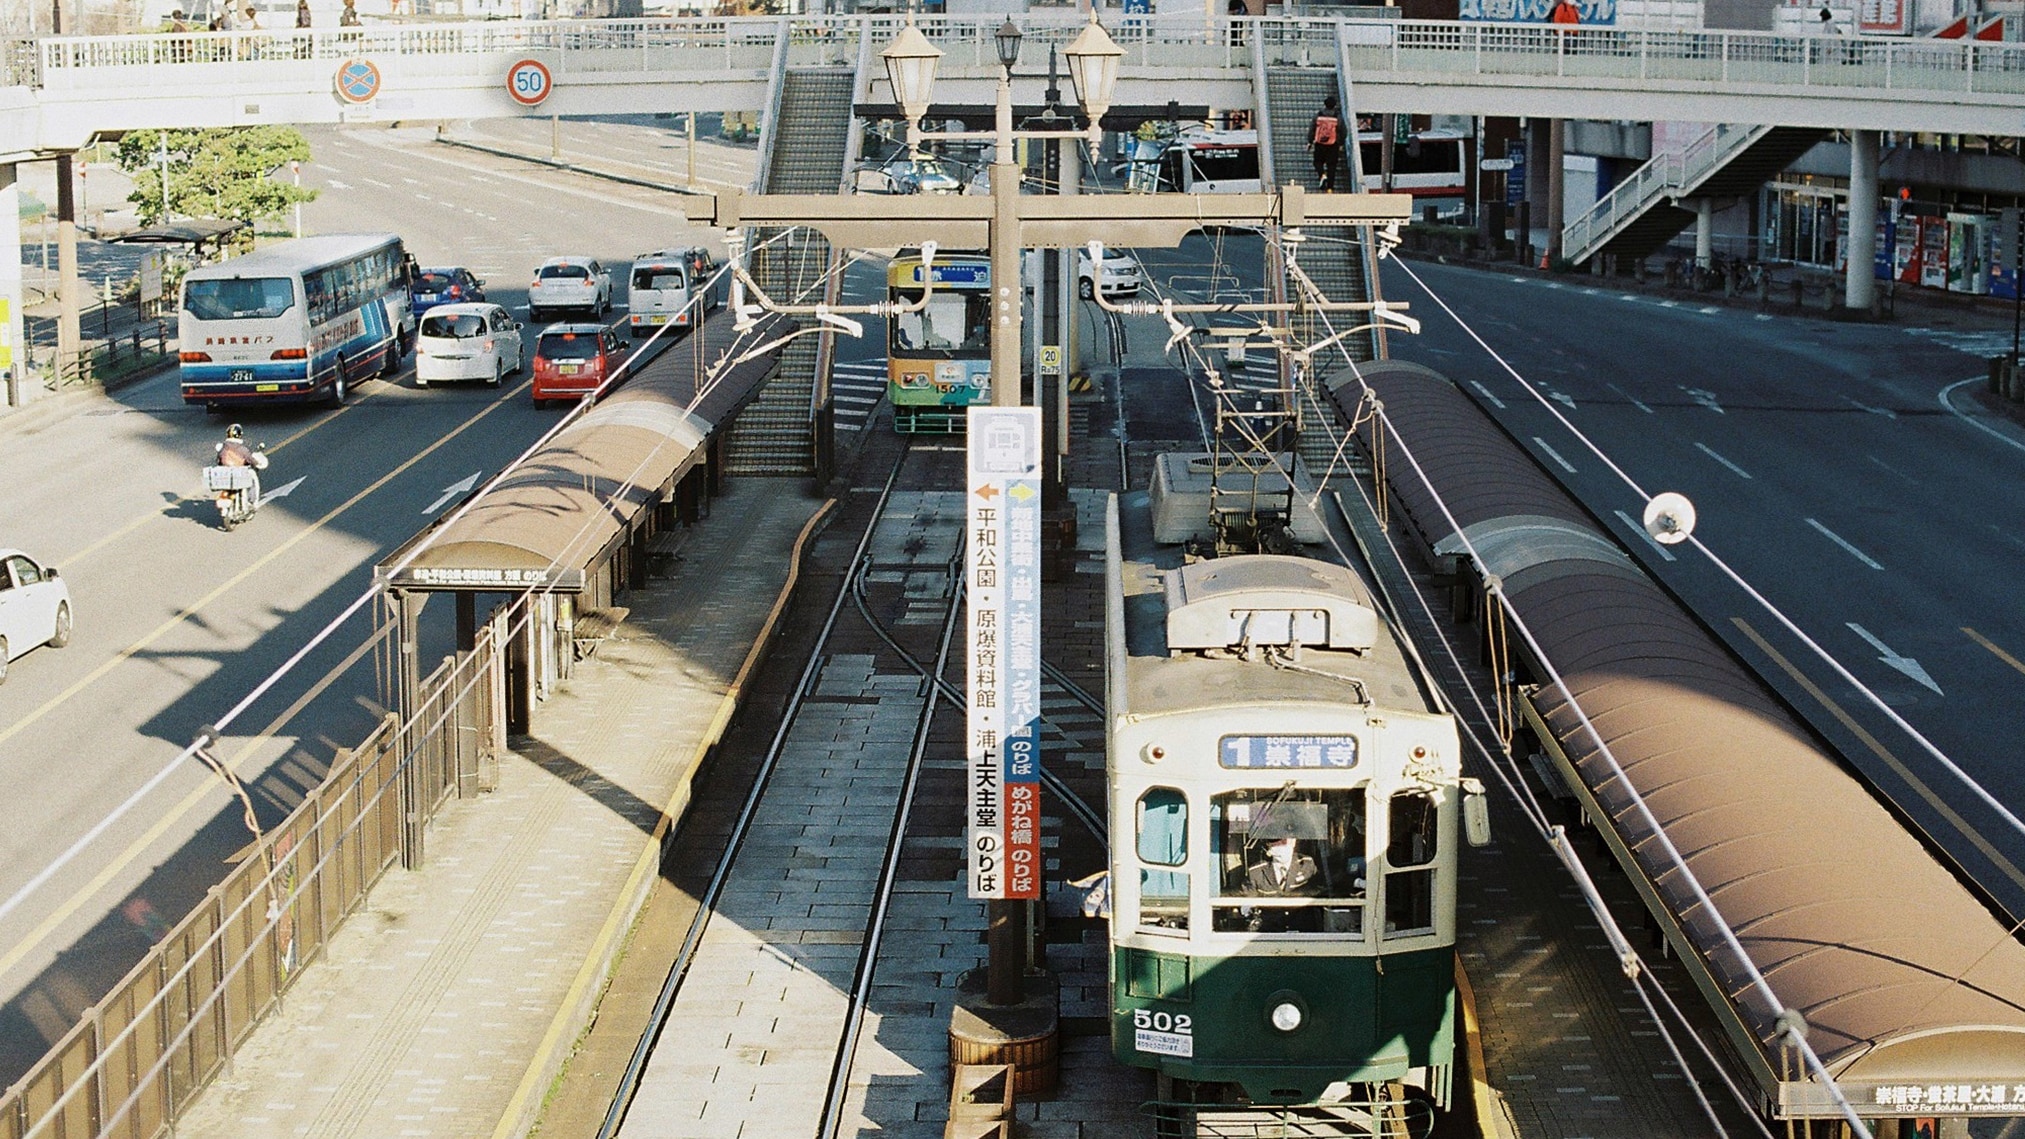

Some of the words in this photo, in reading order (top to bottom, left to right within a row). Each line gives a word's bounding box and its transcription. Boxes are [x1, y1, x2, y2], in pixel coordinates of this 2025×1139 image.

[517, 71, 542, 92] 50
[1044, 350, 1056, 362] 20
[936, 384, 966, 394] 1507
[1227, 737, 1250, 767] 1
[1265, 744, 1354, 767] 崇福寺
[1266, 736, 1313, 746] SOFUKUJI
[1315, 736, 1354, 746] TEMPLE
[1010, 741, 1033, 775] のりば
[1010, 786, 1033, 844] めがね橋
[976, 836, 997, 892] のりば
[1010, 849, 1033, 892] のりば
[1134, 1008, 1192, 1034] 502
[1896, 1104, 1918, 1113] STOP
[1920, 1103, 1934, 1112] For
